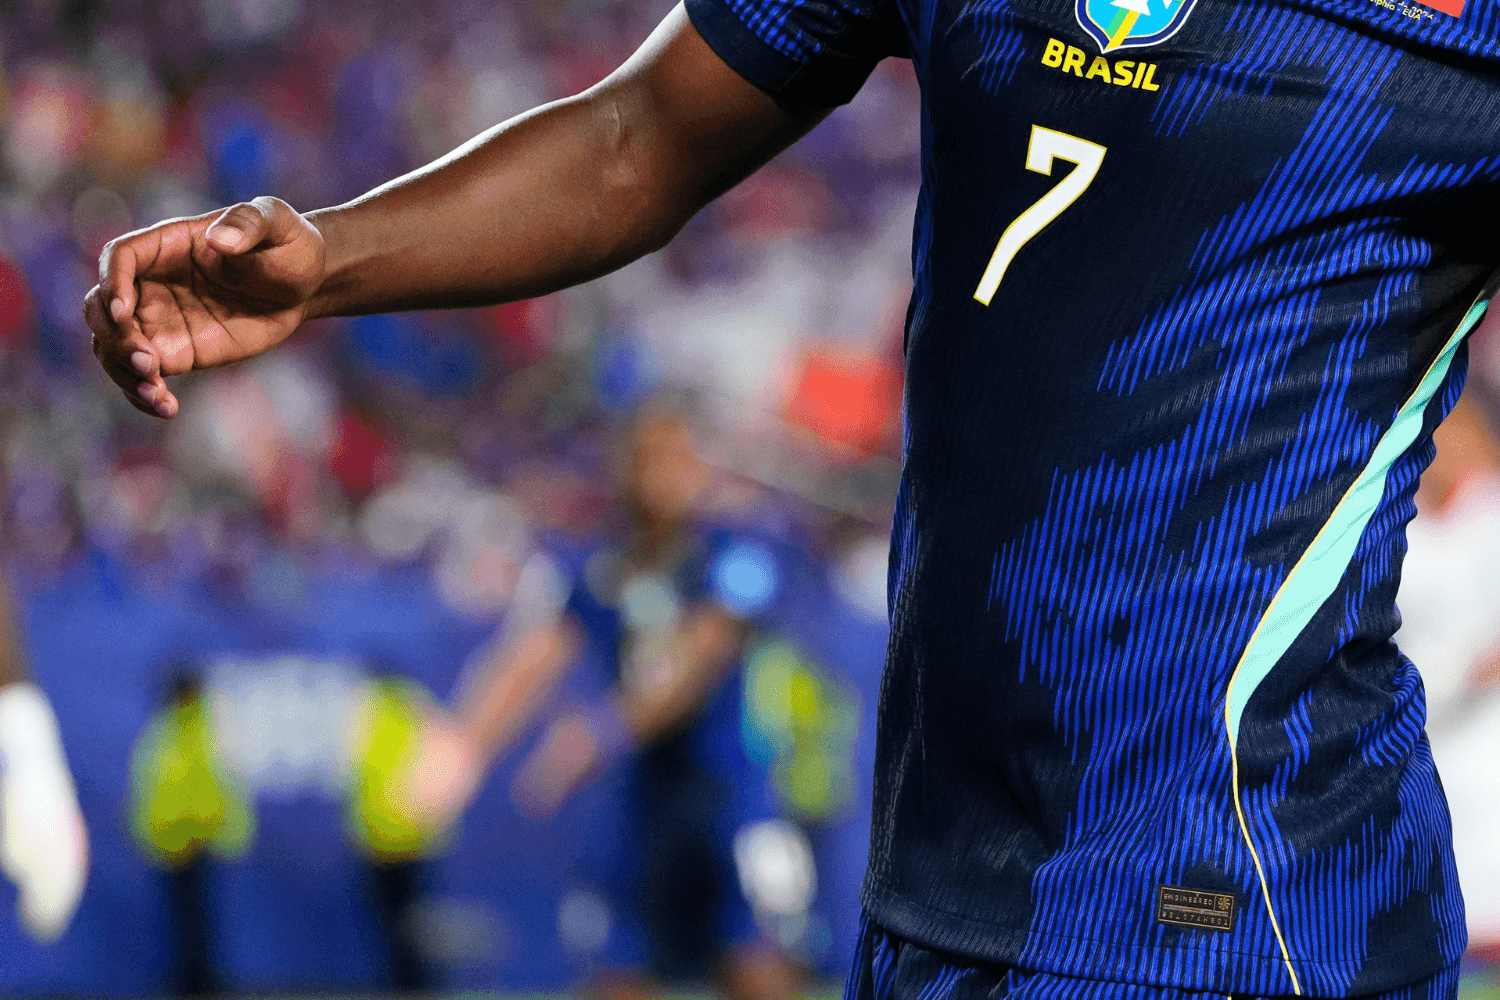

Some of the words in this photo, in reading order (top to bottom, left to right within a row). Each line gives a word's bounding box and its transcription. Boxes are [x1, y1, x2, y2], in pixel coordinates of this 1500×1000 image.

[1402, 6, 1421, 20] EUA
[1041, 37, 1160, 92] BRASIL
[973, 124, 1107, 306] 7
[1163, 893, 1213, 906] ENGINEERED
